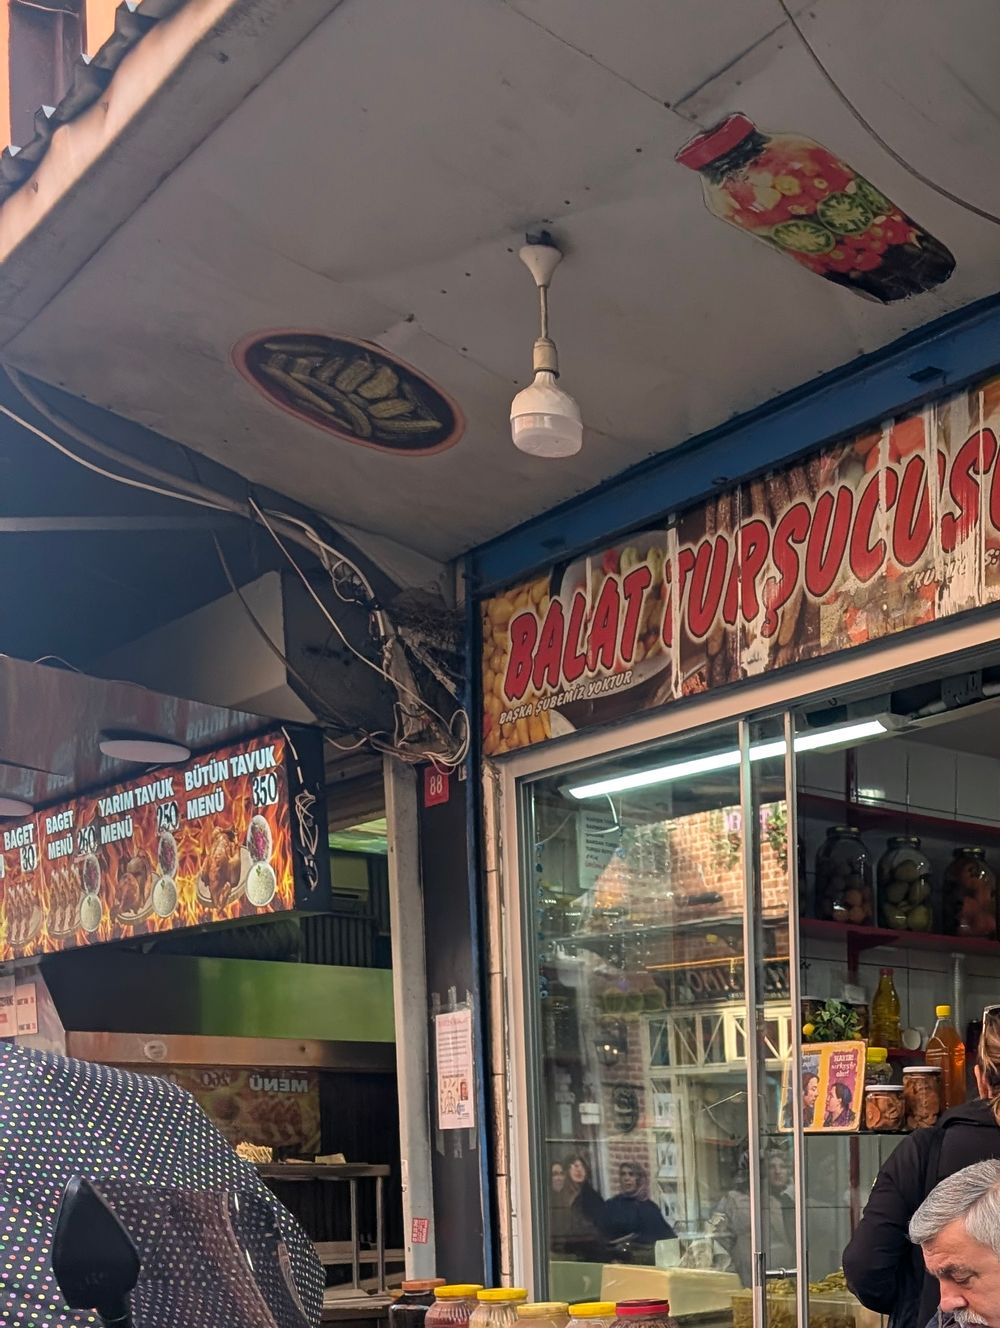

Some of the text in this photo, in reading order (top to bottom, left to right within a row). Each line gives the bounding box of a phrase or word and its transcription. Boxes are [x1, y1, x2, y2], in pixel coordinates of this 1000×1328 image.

[503, 565, 651, 702] BALAT
[499, 703, 533, 725] BAŞKA
[587, 670, 634, 699] YOKTUR
[184, 745, 277, 791] BÜTÜN TAVUK
[430, 774, 443, 796] 88
[98, 777, 175, 818] YARIM TAVUK
[186, 772, 279, 820] MENÜ 350
[3, 823, 34, 851] BAGET
[45, 810, 74, 835] BAGET
[100, 815, 133, 846] MENÜ
[47, 833, 73, 860] MENÜ
